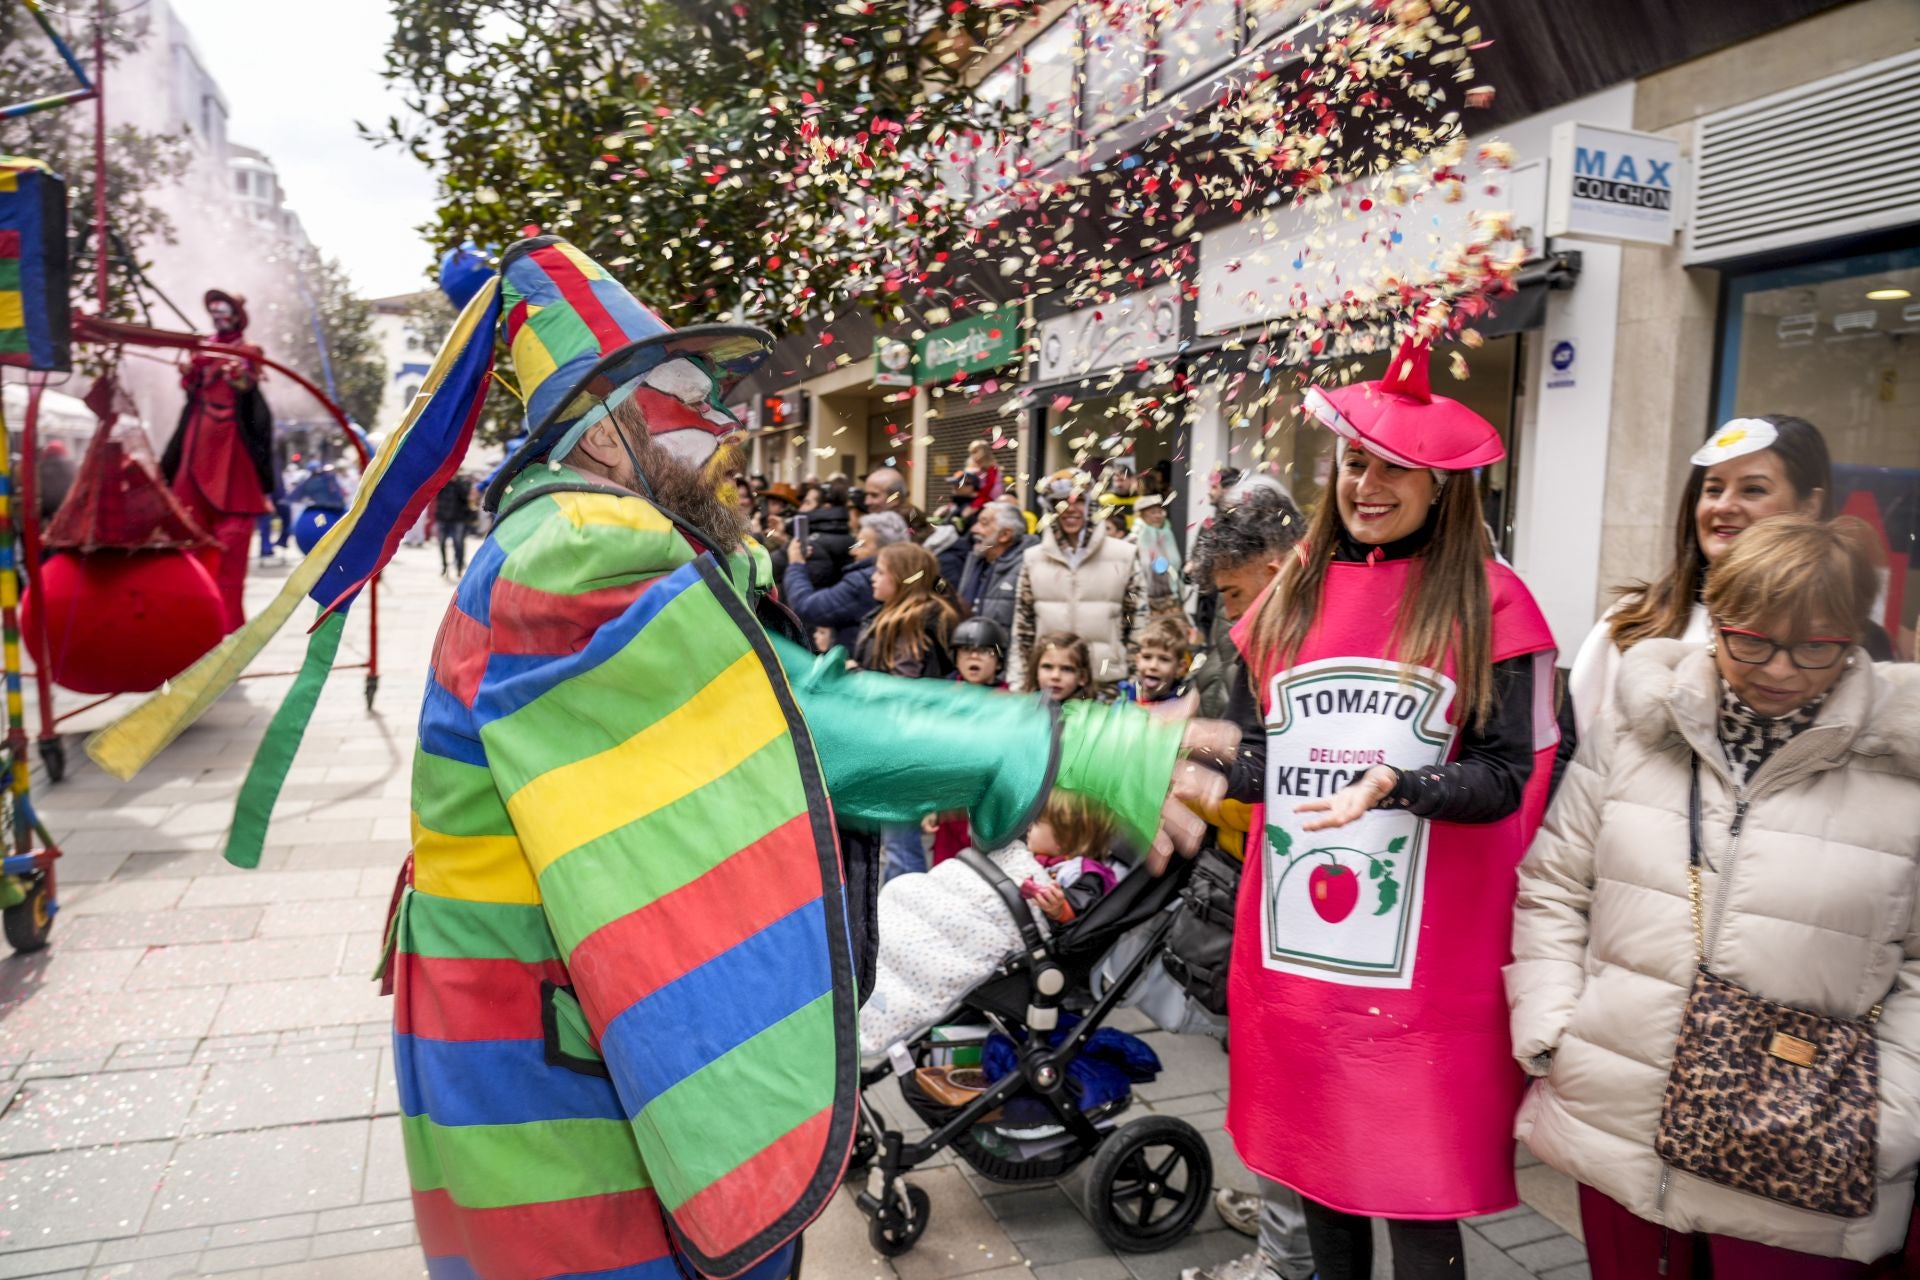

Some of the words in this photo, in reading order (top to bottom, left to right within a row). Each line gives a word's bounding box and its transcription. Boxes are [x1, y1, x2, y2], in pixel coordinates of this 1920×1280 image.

[1575, 147, 1671, 187] MAX
[1574, 178, 1670, 210] COLCHON
[1295, 689, 1417, 720] TOMATO
[1309, 748, 1385, 764] DELICIOUS
[1277, 766, 1360, 797] KETC
